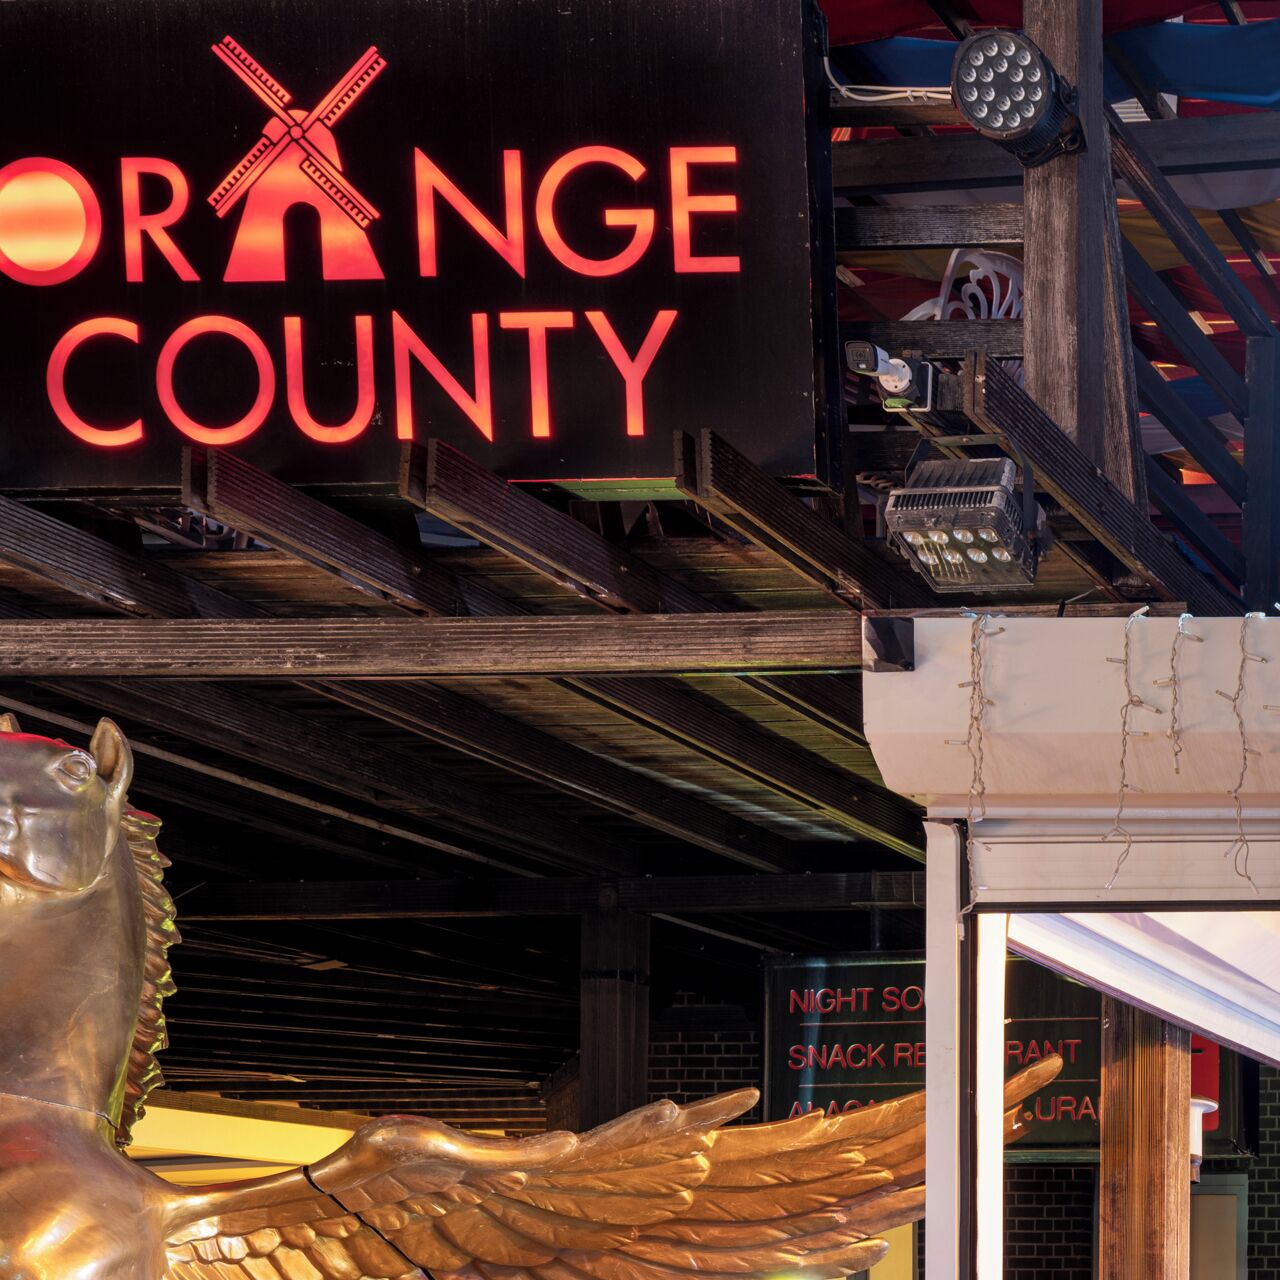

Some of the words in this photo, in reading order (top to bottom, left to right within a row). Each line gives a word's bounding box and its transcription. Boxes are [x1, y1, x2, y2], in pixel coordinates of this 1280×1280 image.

[46, 310, 678, 447] COUNTY
[788, 986, 875, 1014] NIGHT
[787, 1043, 887, 1070] SNACK
